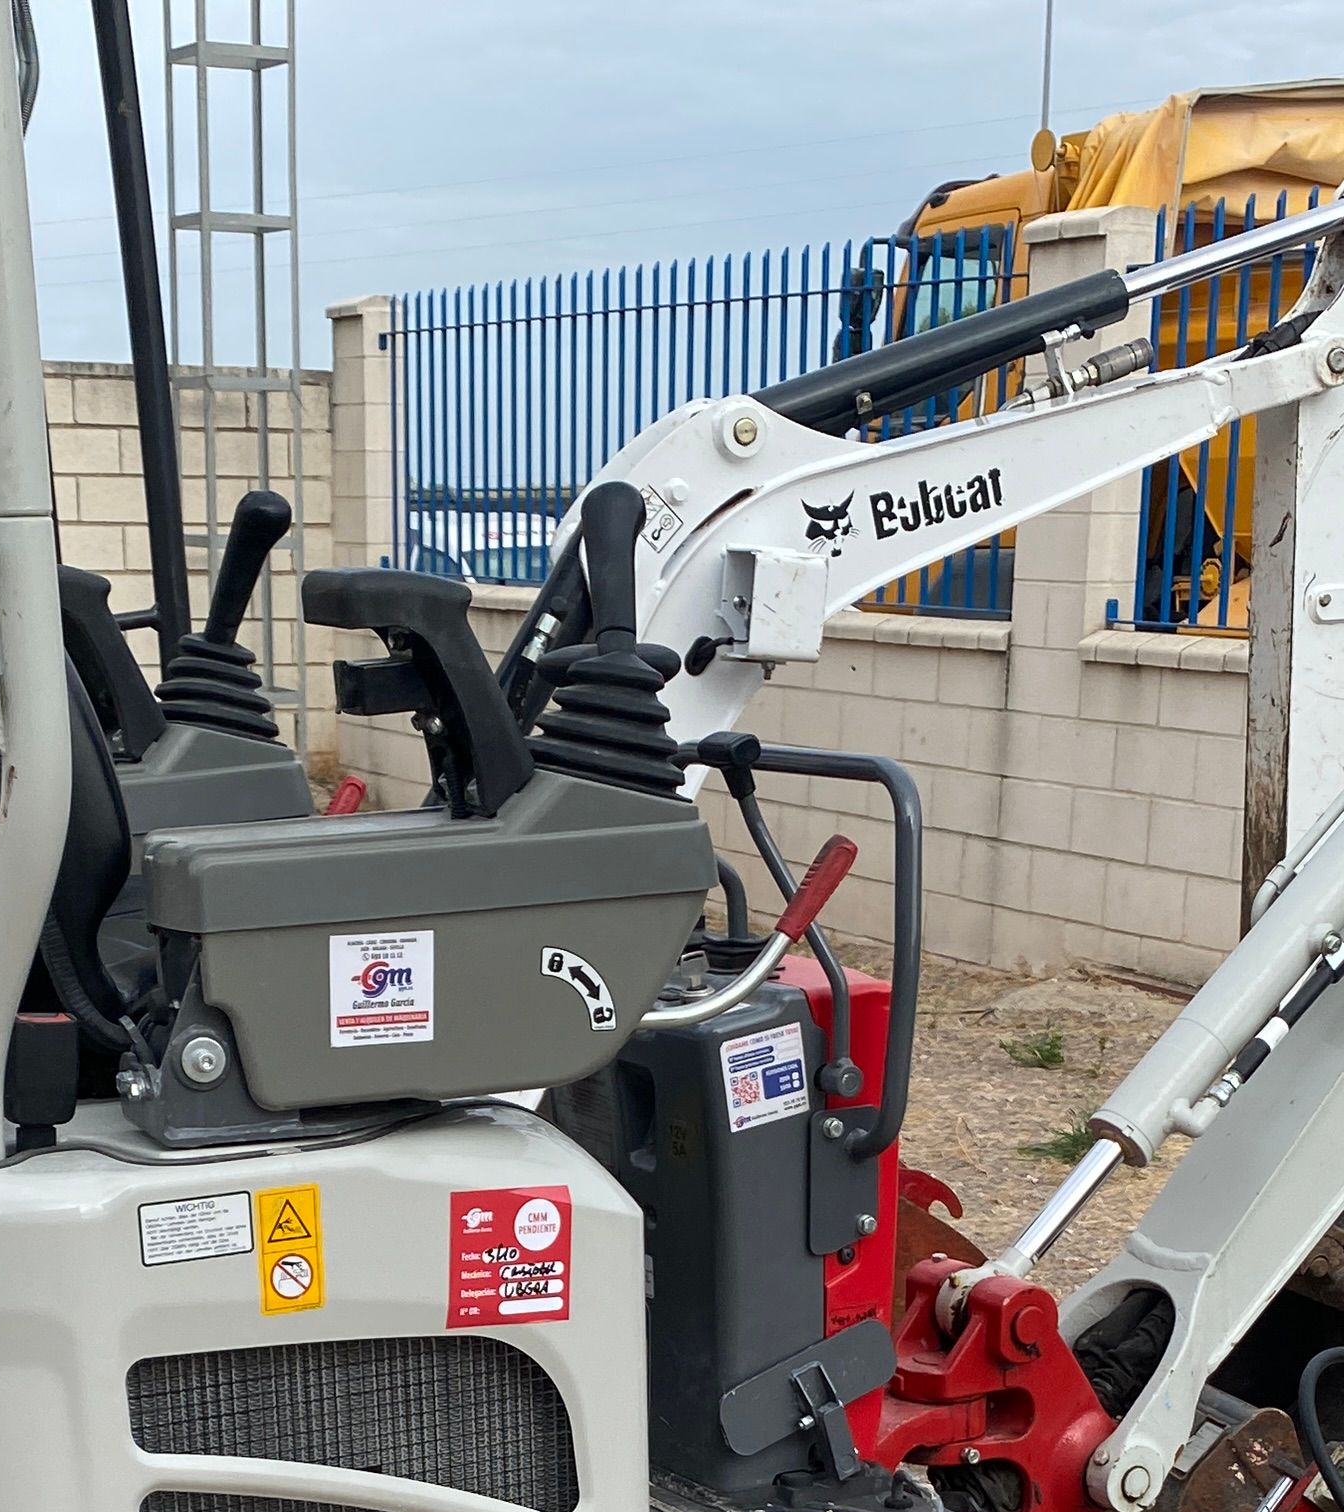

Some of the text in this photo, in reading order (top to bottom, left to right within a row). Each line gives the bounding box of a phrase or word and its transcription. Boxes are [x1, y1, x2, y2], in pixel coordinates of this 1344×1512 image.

[870, 467, 1002, 540] Bobcat
[352, 1000, 389, 1010] Guillermo
[175, 1200, 216, 1213] WICHTIG
[528, 1211, 549, 1224] CMM
[518, 1223, 557, 1236] PENDIENTE
